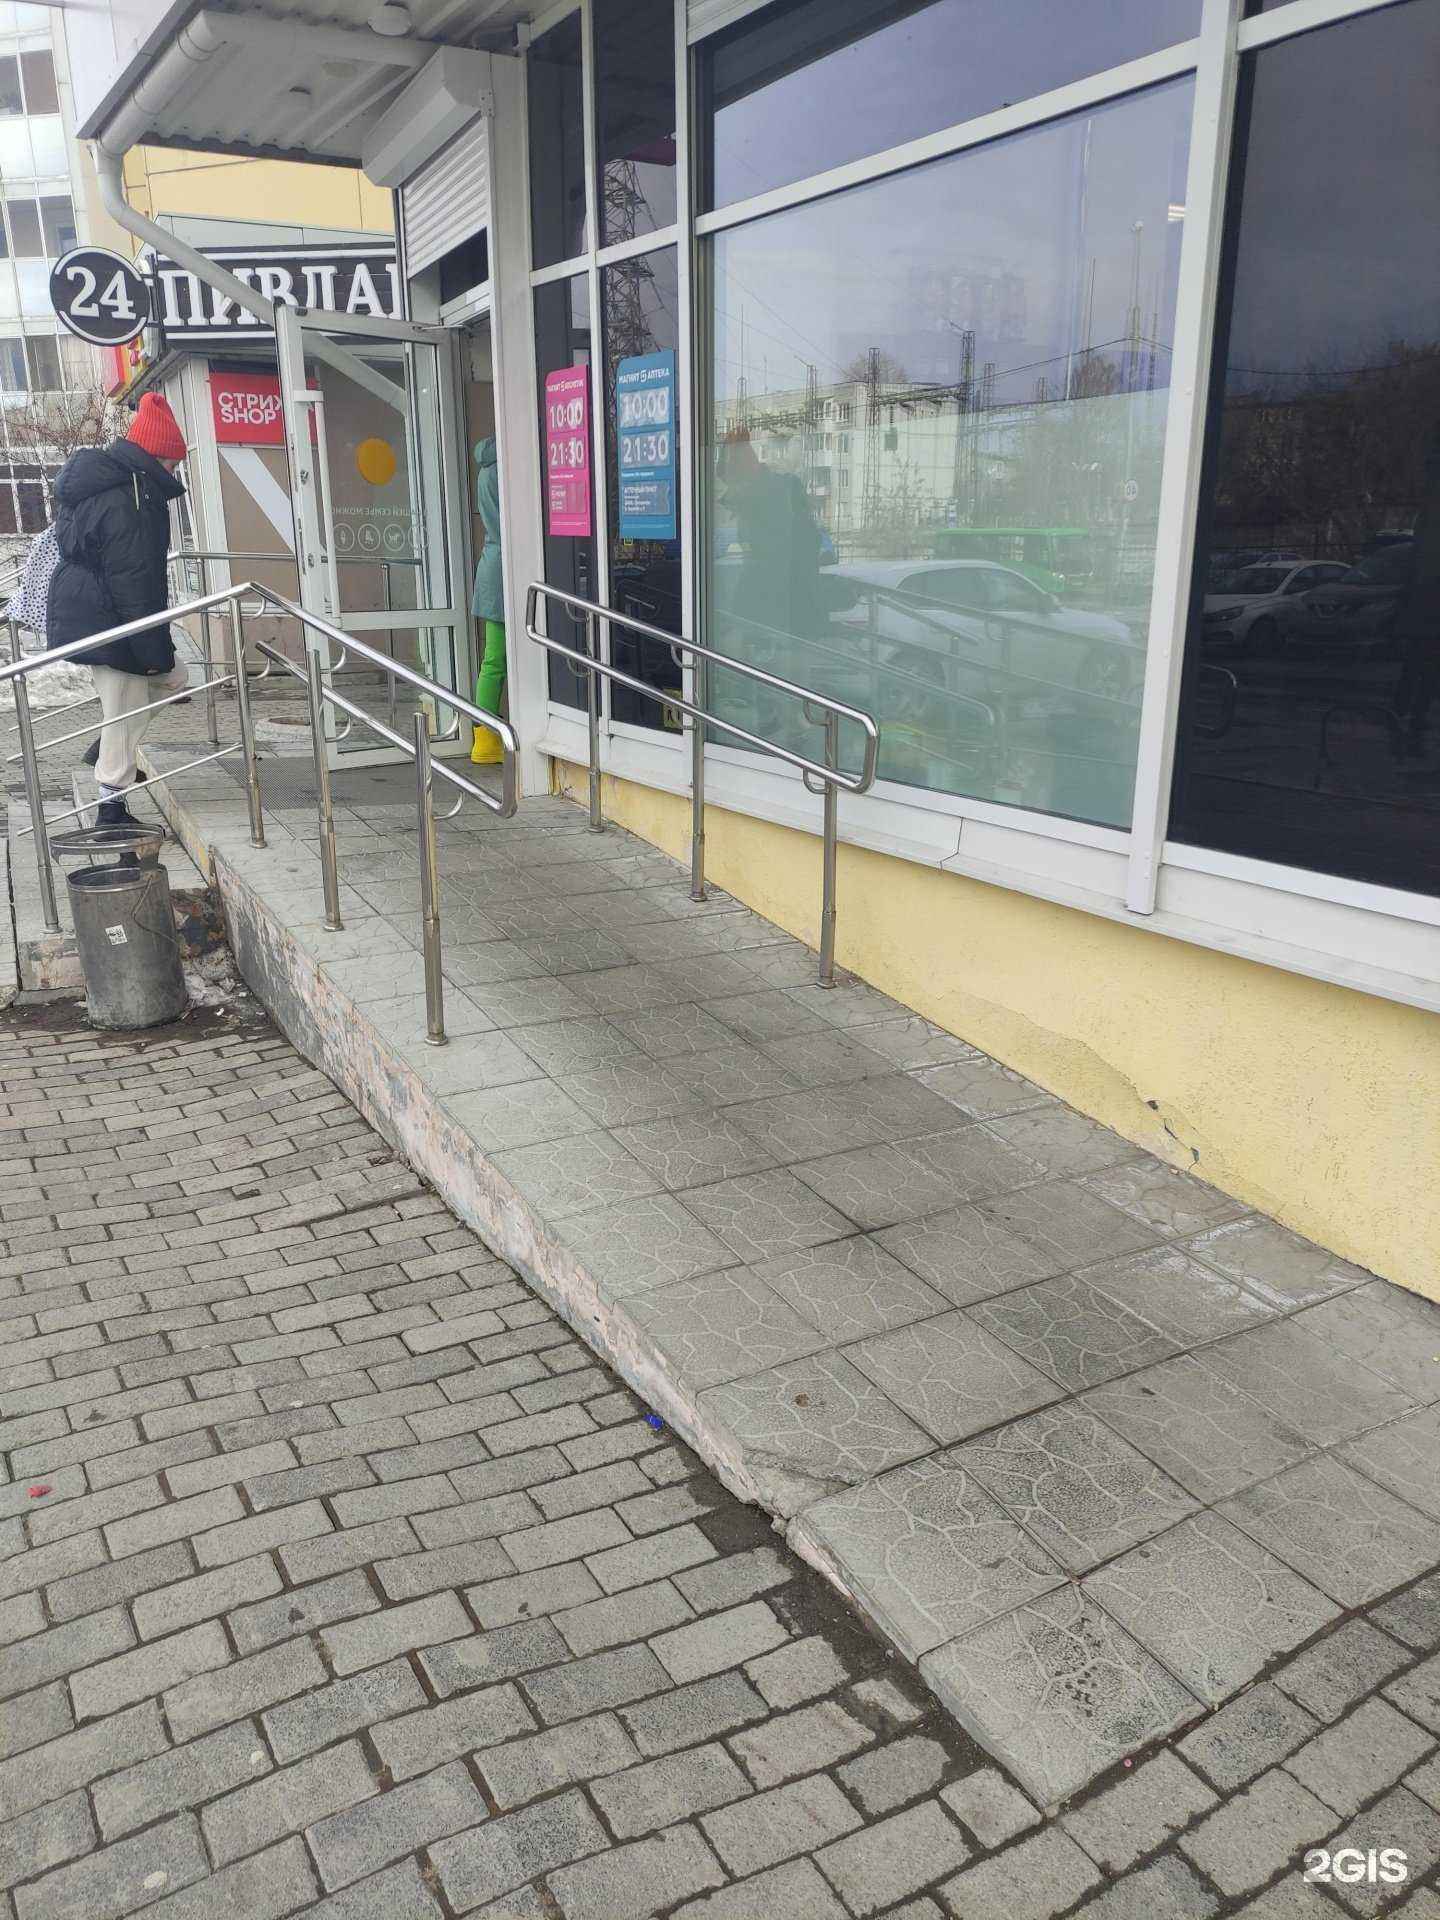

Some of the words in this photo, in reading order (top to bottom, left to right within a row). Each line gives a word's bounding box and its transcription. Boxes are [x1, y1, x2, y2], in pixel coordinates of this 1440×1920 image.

[66, 266, 136, 320] 24
[158, 263, 401, 326] ПИВЛА
[221, 407, 276, 424] SHOP
[550, 399, 583, 430] 10:00
[622, 389, 668, 422] 10:00
[551, 437, 584, 467] 21:30
[623, 434, 668, 464] 21:30
